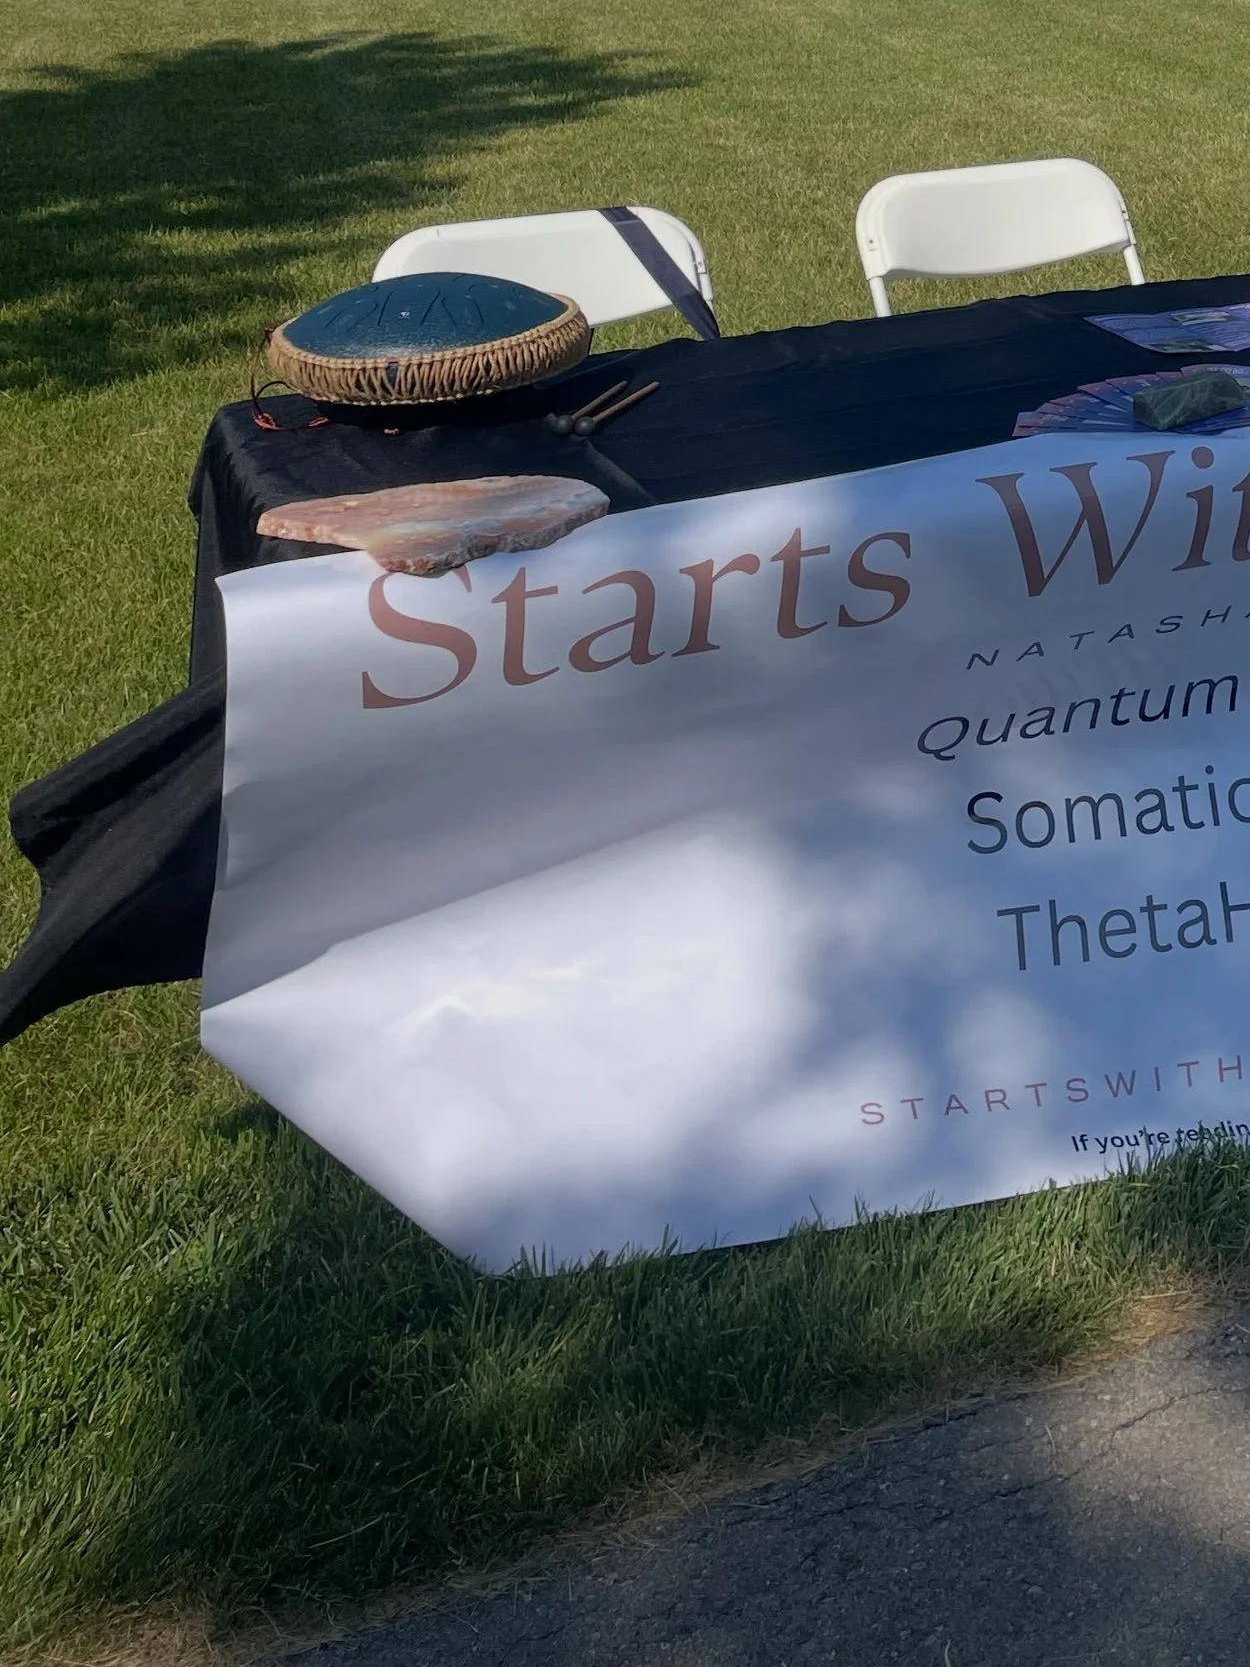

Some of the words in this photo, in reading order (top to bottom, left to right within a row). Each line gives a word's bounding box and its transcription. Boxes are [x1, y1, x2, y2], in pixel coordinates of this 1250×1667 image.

[361, 526, 912, 710] Starts
[916, 672, 1238, 761] Quantum
[1071, 1134, 1091, 1152] If
